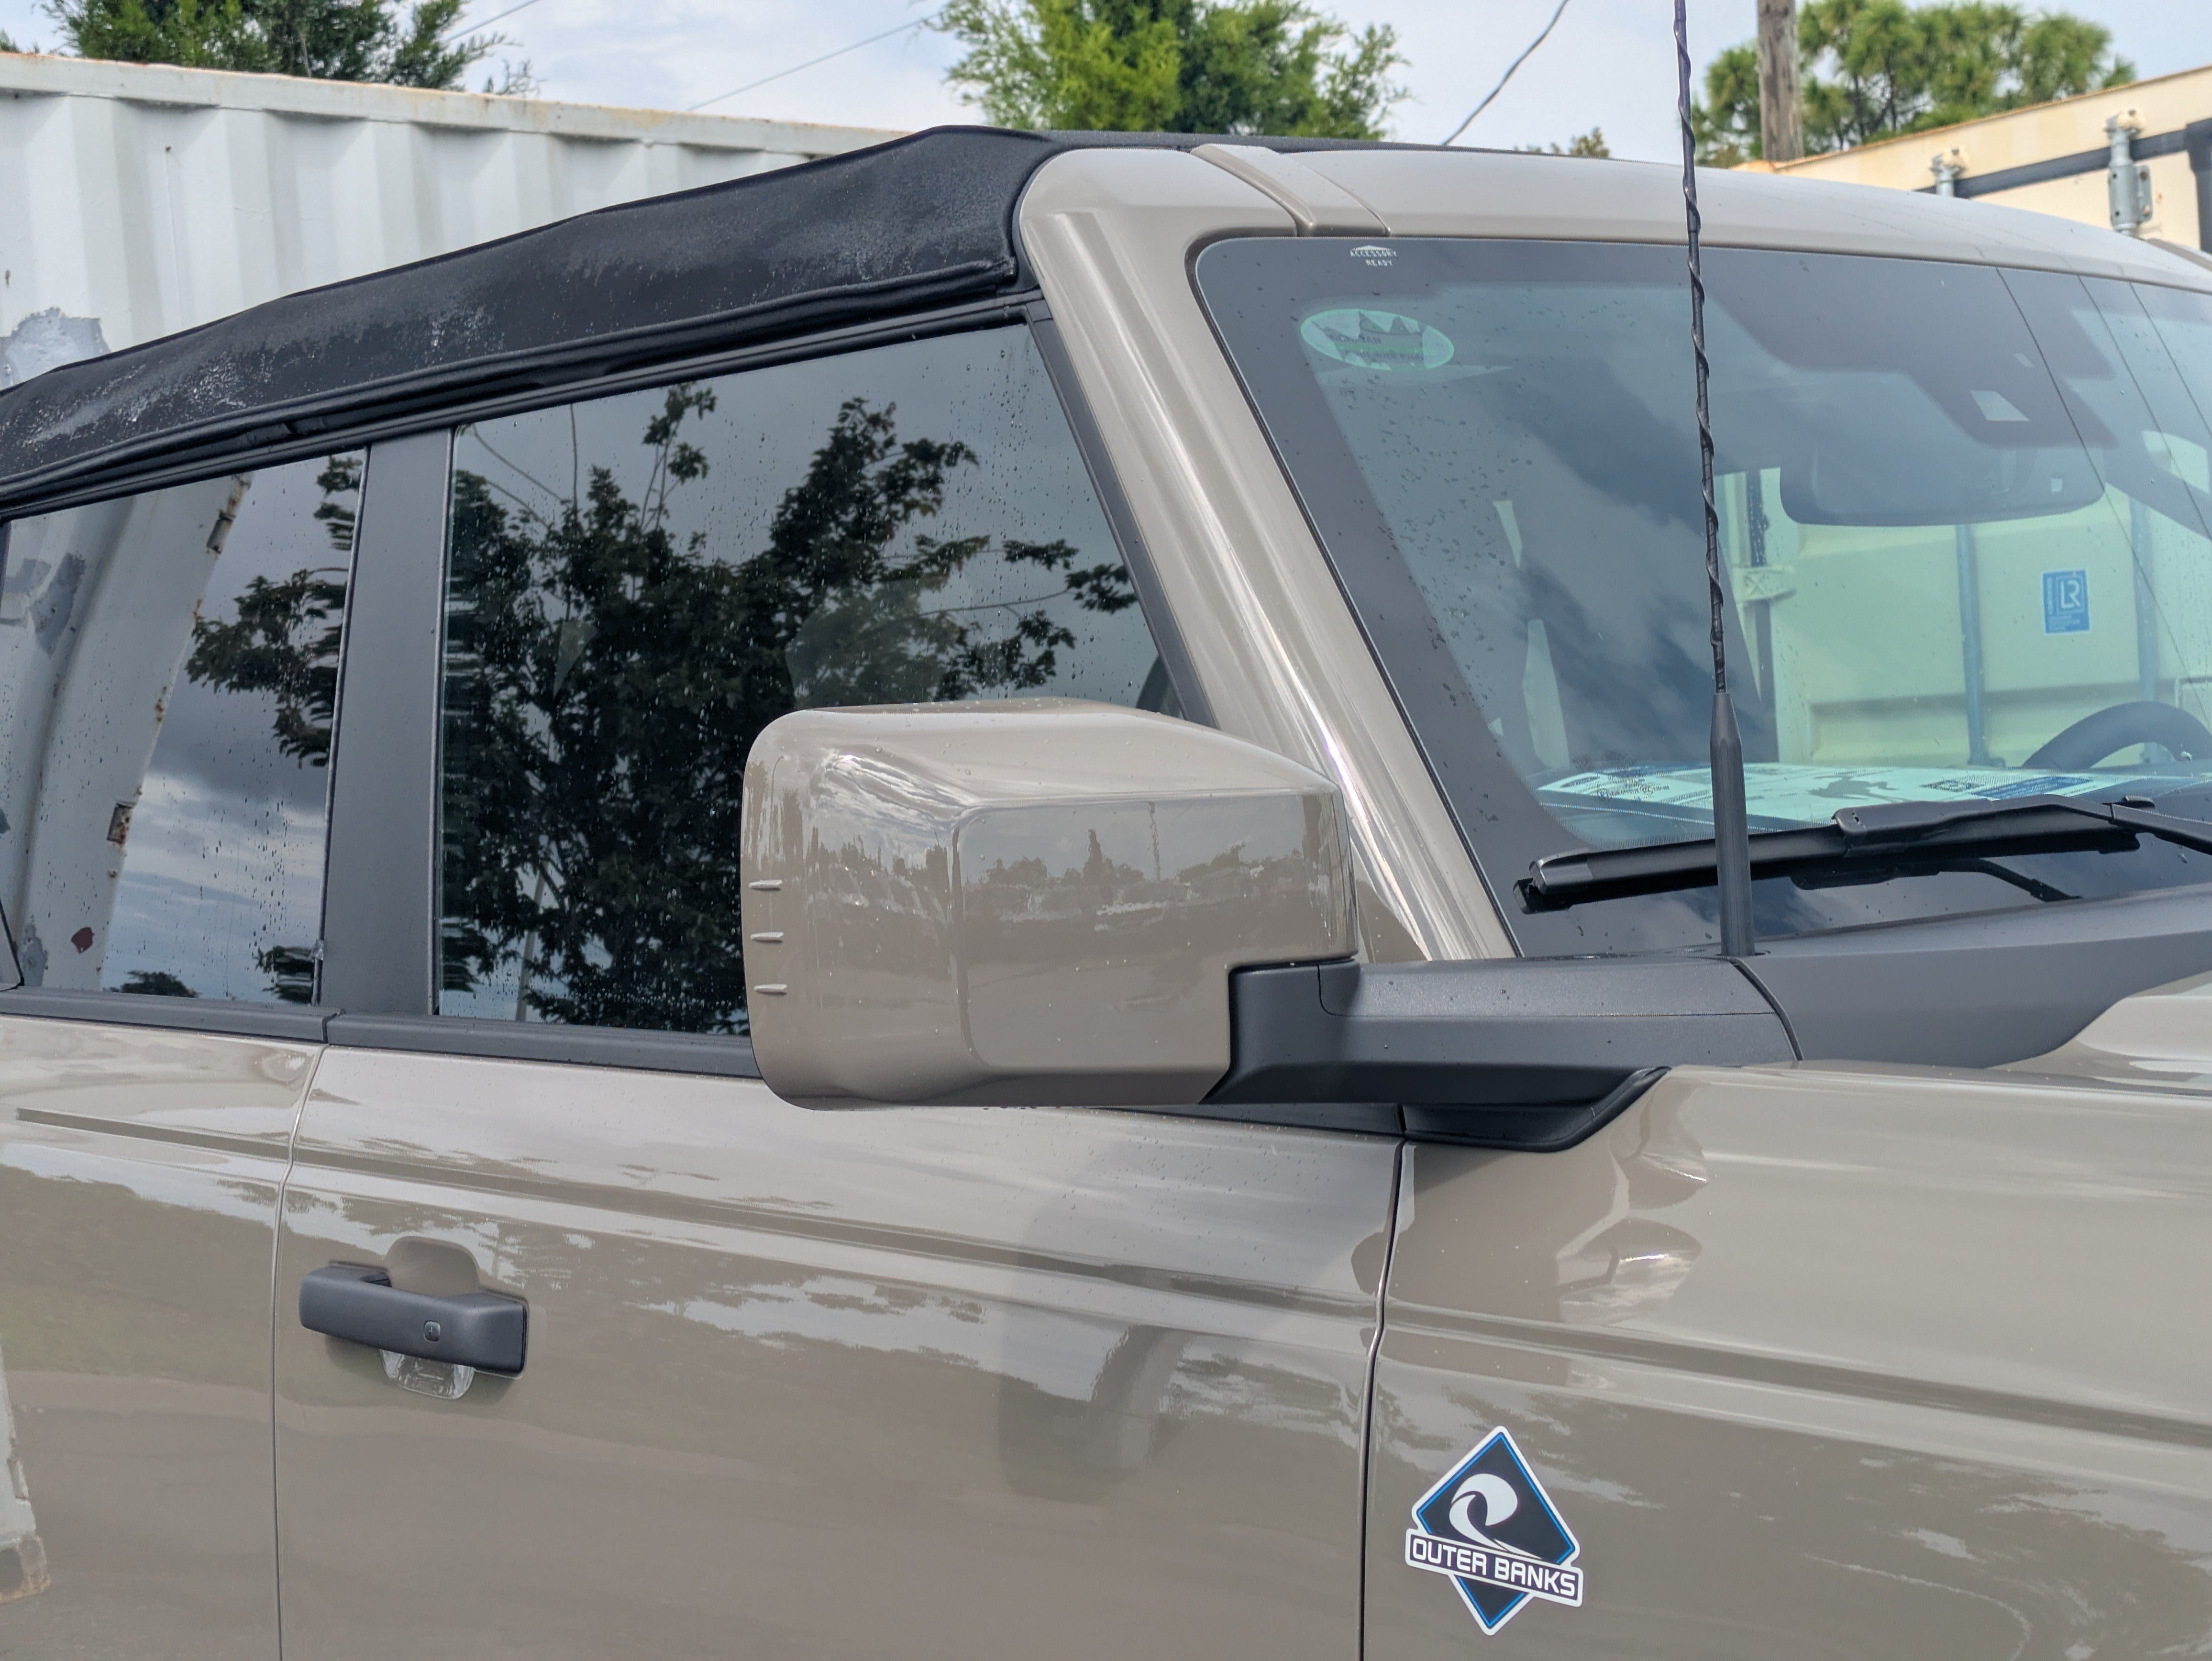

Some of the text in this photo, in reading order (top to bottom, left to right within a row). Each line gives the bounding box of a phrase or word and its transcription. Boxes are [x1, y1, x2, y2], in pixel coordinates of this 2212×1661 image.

[2060, 579, 2081, 609] LR
[1412, 1538, 1576, 1597] OUTER BANKS
